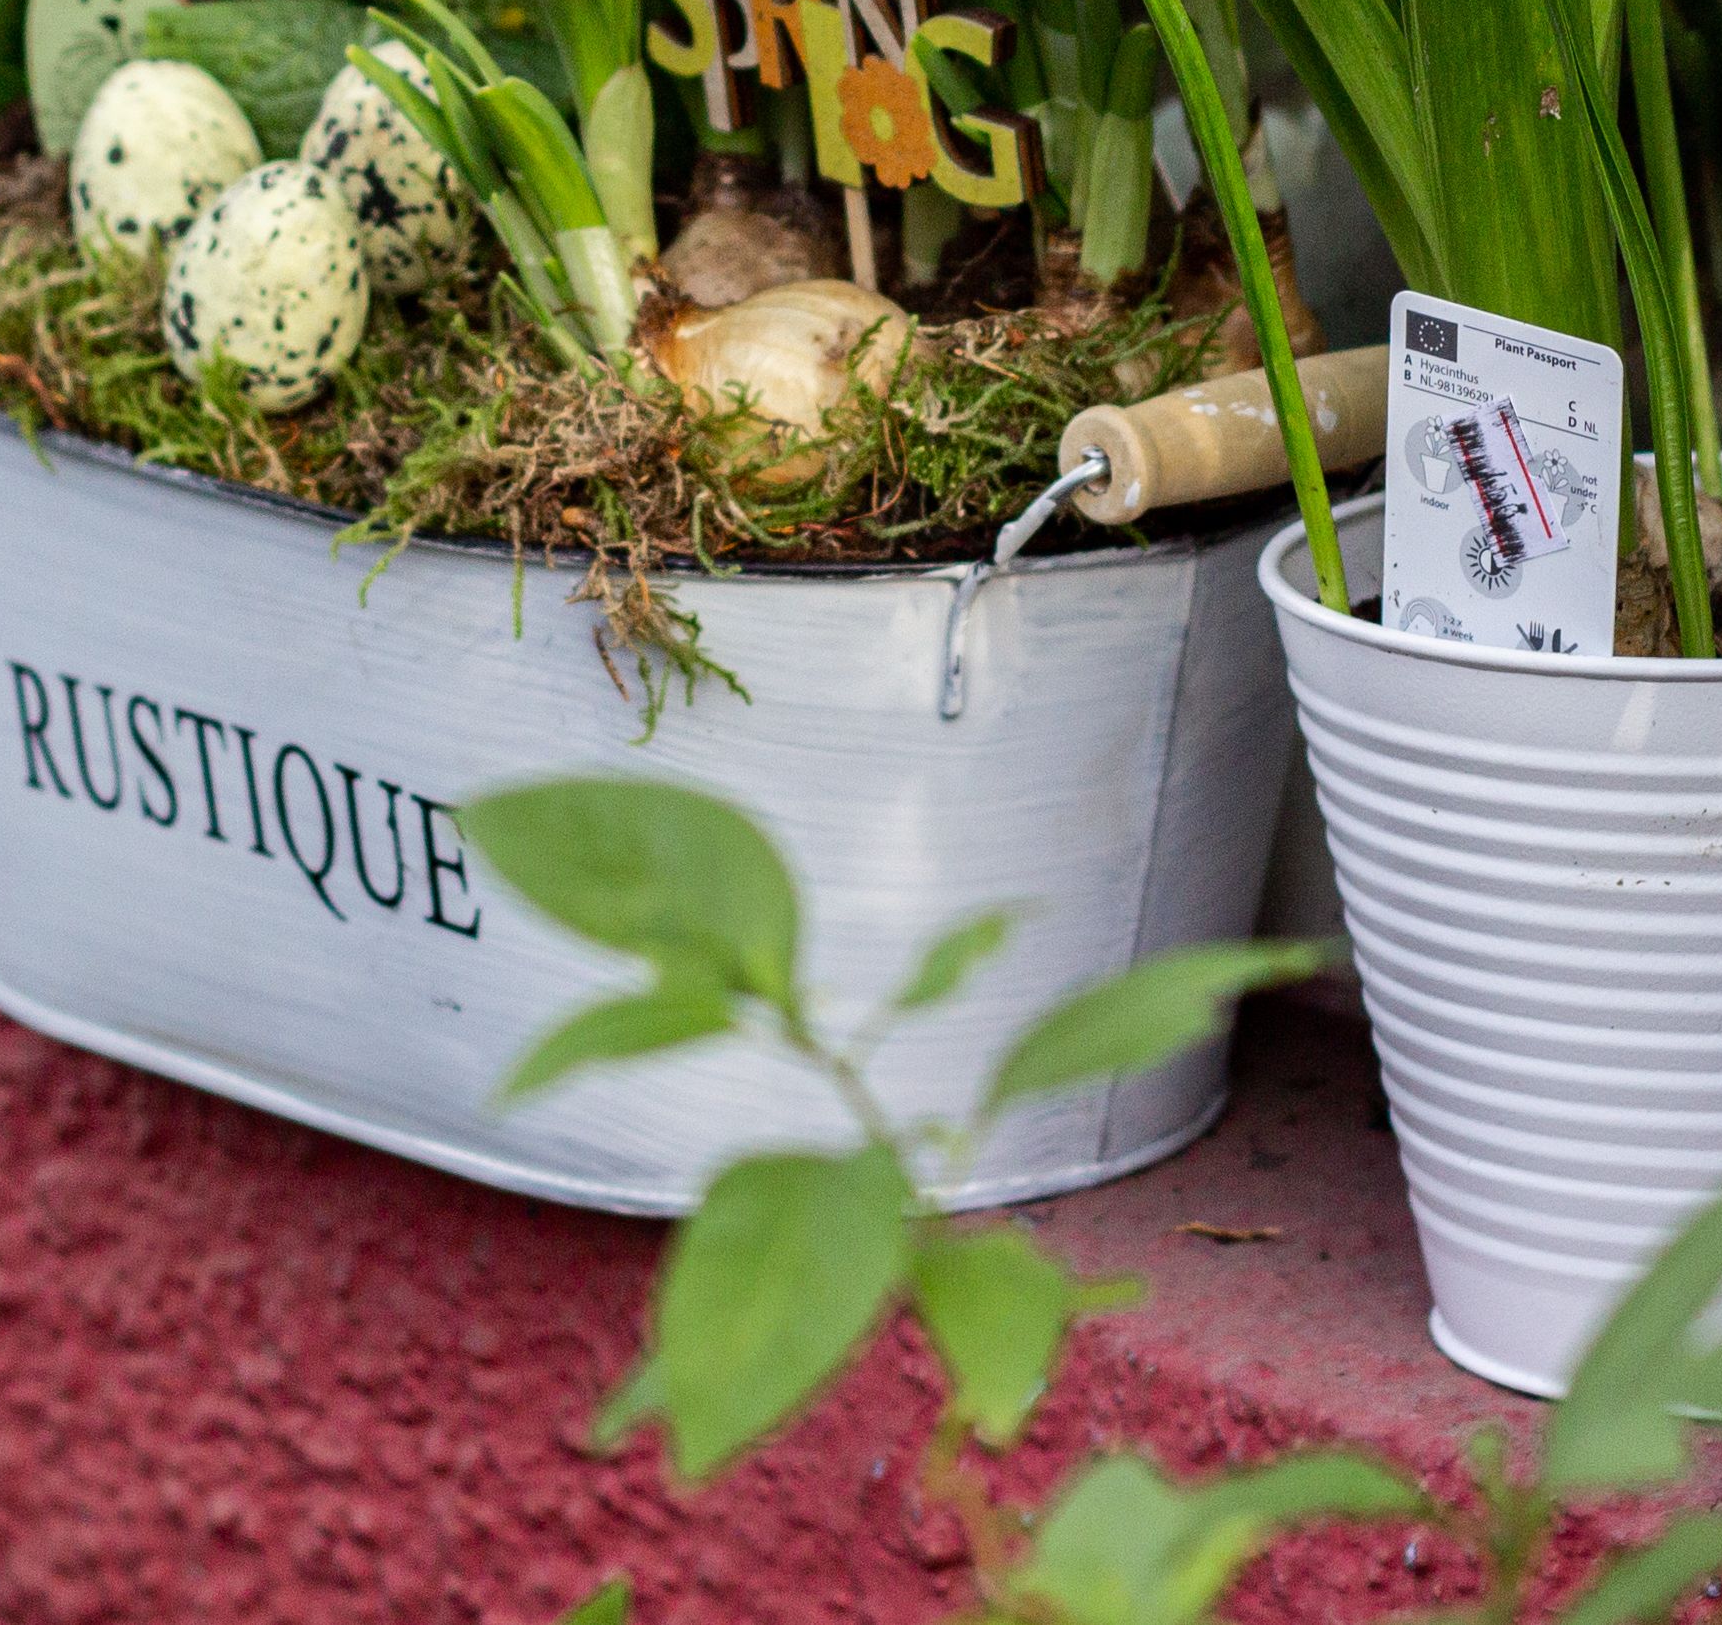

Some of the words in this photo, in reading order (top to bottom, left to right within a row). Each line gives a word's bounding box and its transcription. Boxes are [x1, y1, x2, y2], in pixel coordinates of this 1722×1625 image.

[1495, 337, 1524, 356] Plant
[1527, 346, 1577, 370] Passport
[1404, 354, 1413, 365] A
[1420, 358, 1479, 384] Hyacinthus
[1404, 370, 1412, 381] B
[1568, 400, 1576, 412] C
[1568, 416, 1577, 428] D
[1584, 421, 1599, 435] NL
[1582, 475, 1598, 486] not
[1570, 486, 1597, 500] under
[1420, 494, 1451, 511] indoor
[1450, 628, 1475, 642] week
[7, 659, 483, 939] RUSTIQUE
